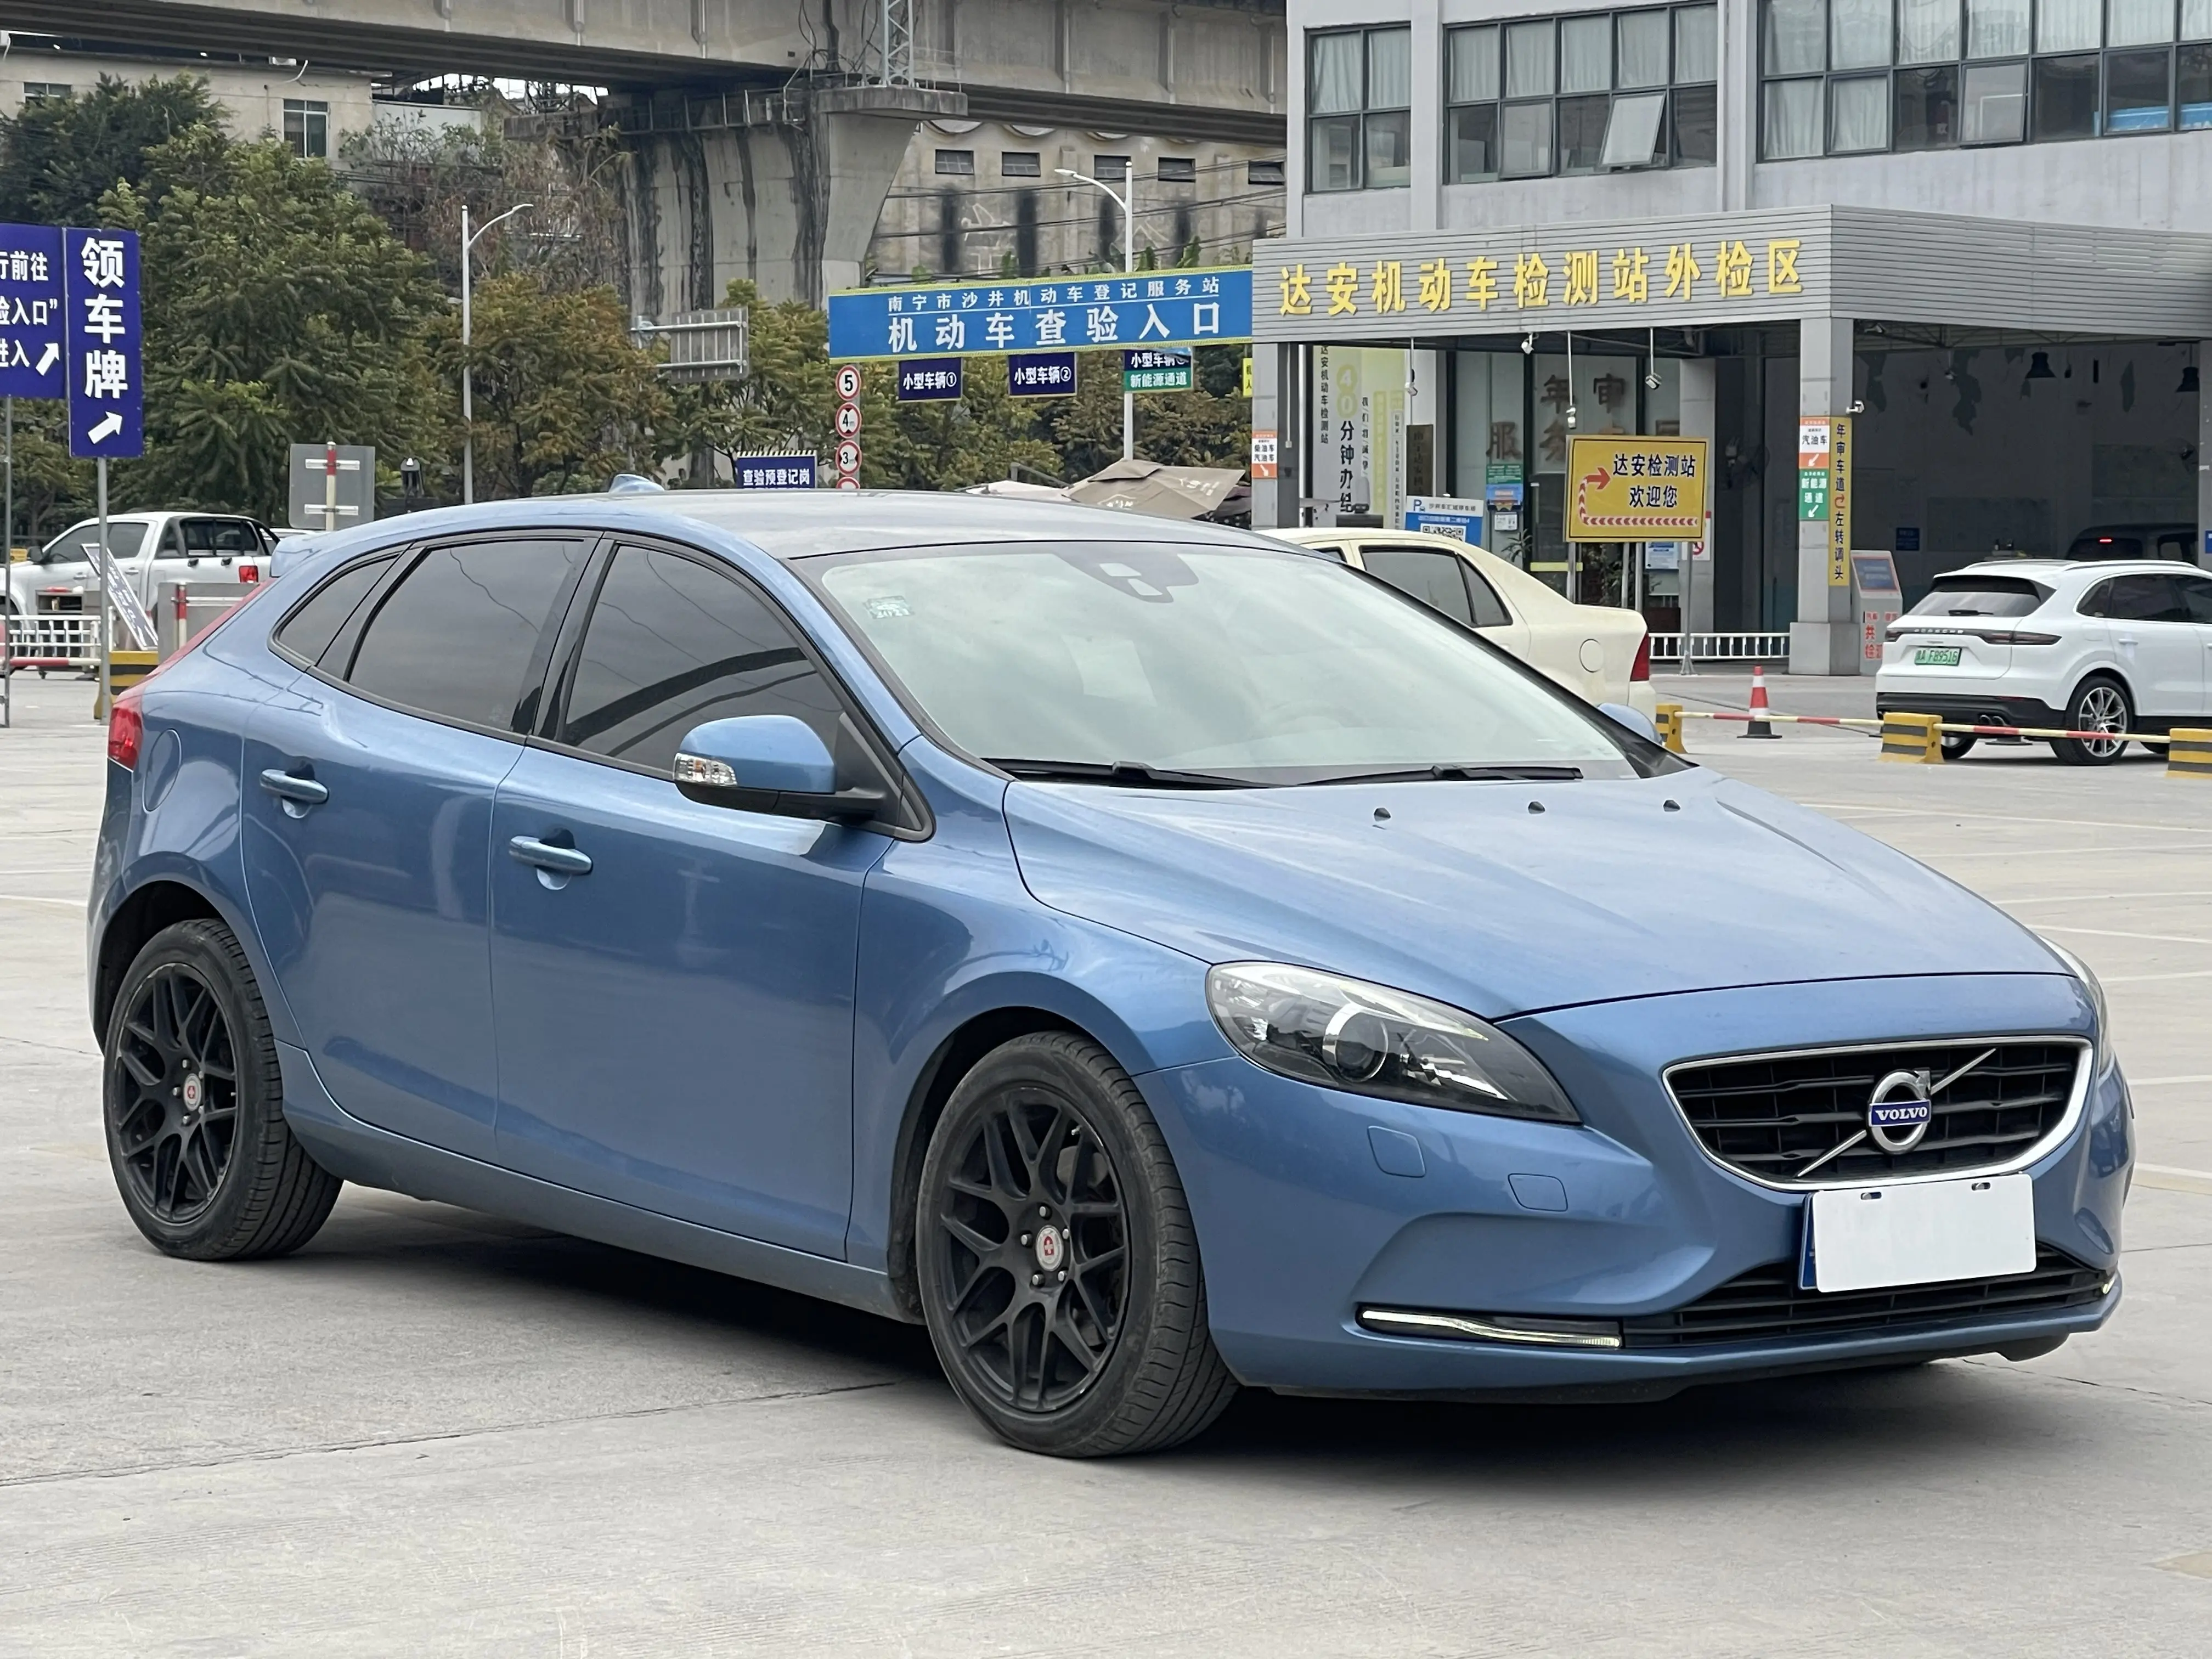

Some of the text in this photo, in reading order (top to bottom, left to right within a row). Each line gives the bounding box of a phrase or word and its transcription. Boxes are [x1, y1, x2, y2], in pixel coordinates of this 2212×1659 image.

[1279, 240, 1803, 316] 达安机动车检测站外检区
[888, 276, 1220, 312] 南宁市沙井机动车登记服务站
[81, 236, 128, 399] 领车牌
[888, 302, 1220, 353] 机动车查验入口
[844, 374, 853, 392] 5
[1130, 371, 1187, 388] 新能源通道
[1802, 435, 1827, 445] 汽油车
[1613, 453, 1696, 478] 达安检测站
[1835, 423, 1846, 492] 年审车道
[743, 468, 810, 486] 查验预登记岗
[1629, 485, 1678, 508] 欢迎您
[1875, 1107, 1927, 1121] VOLVO
